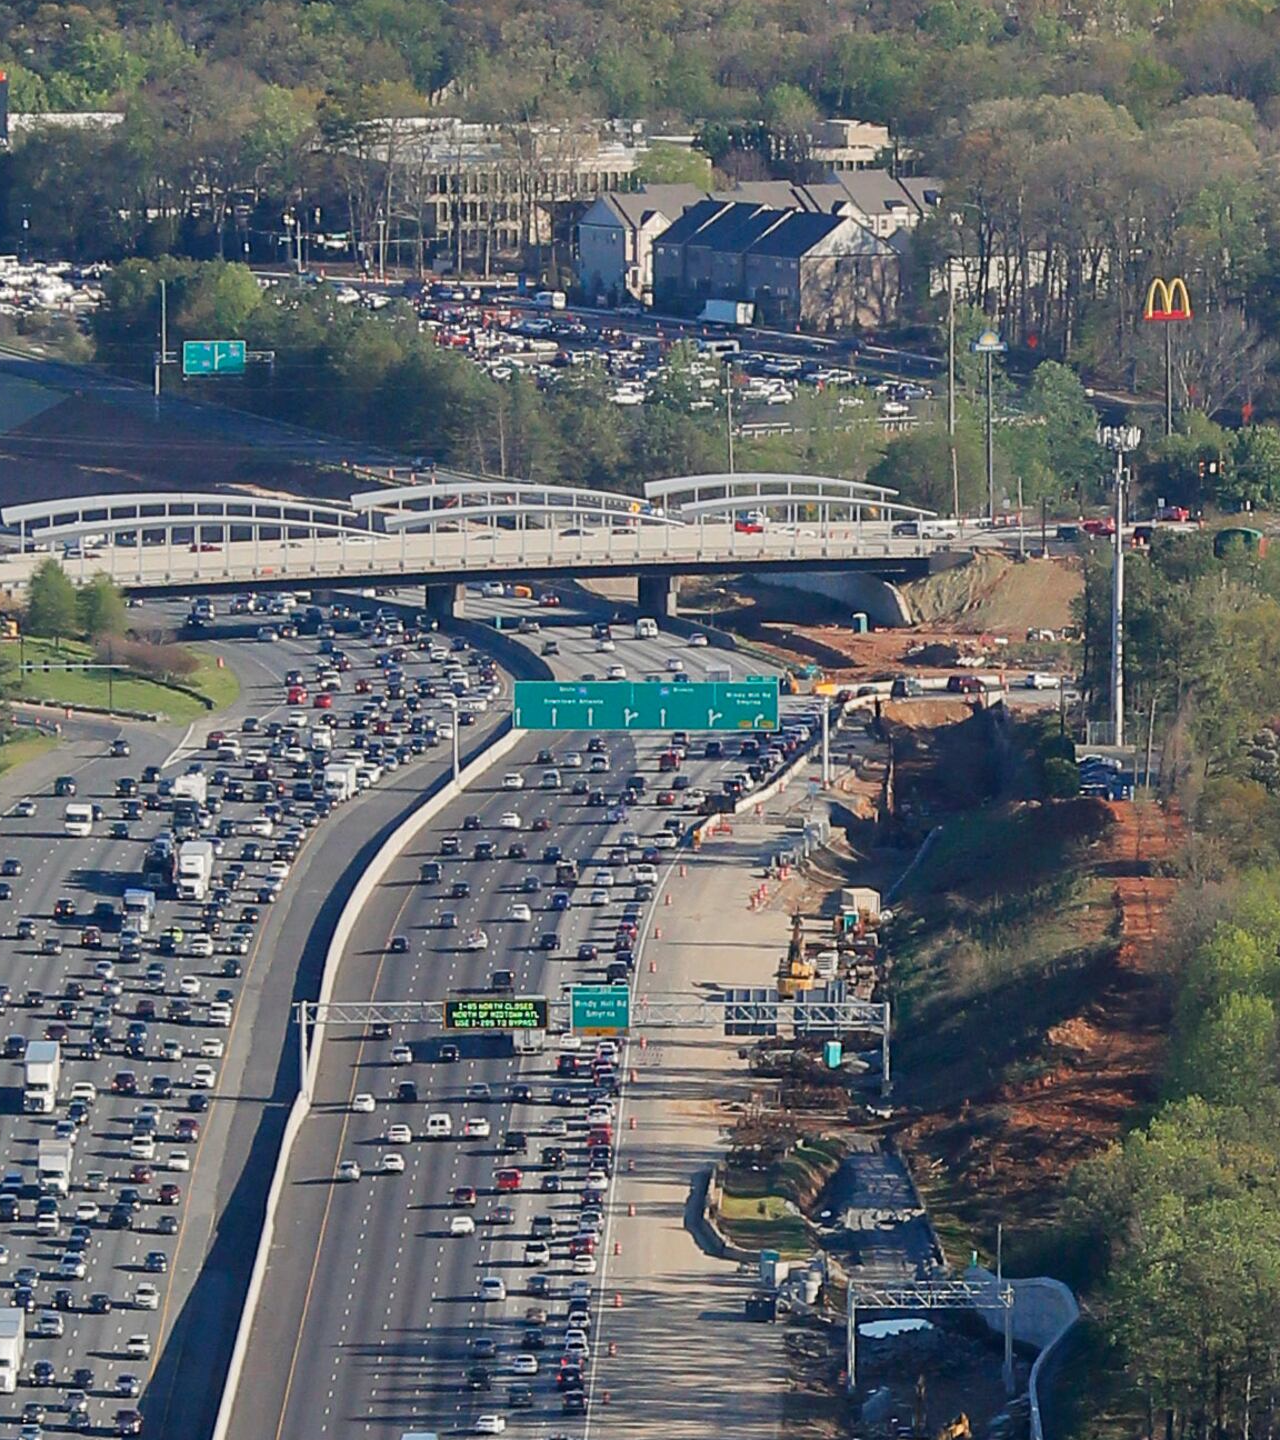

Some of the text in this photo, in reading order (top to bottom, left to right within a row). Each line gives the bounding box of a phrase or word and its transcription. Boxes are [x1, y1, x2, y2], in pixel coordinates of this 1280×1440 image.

[479, 1002, 503, 1010] NORTH
[504, 1002, 534, 1010] CLOSED
[586, 1010, 615, 1019] Smyrna
[497, 1019, 507, 1027] TO
[508, 1019, 538, 1027] BYPASS
